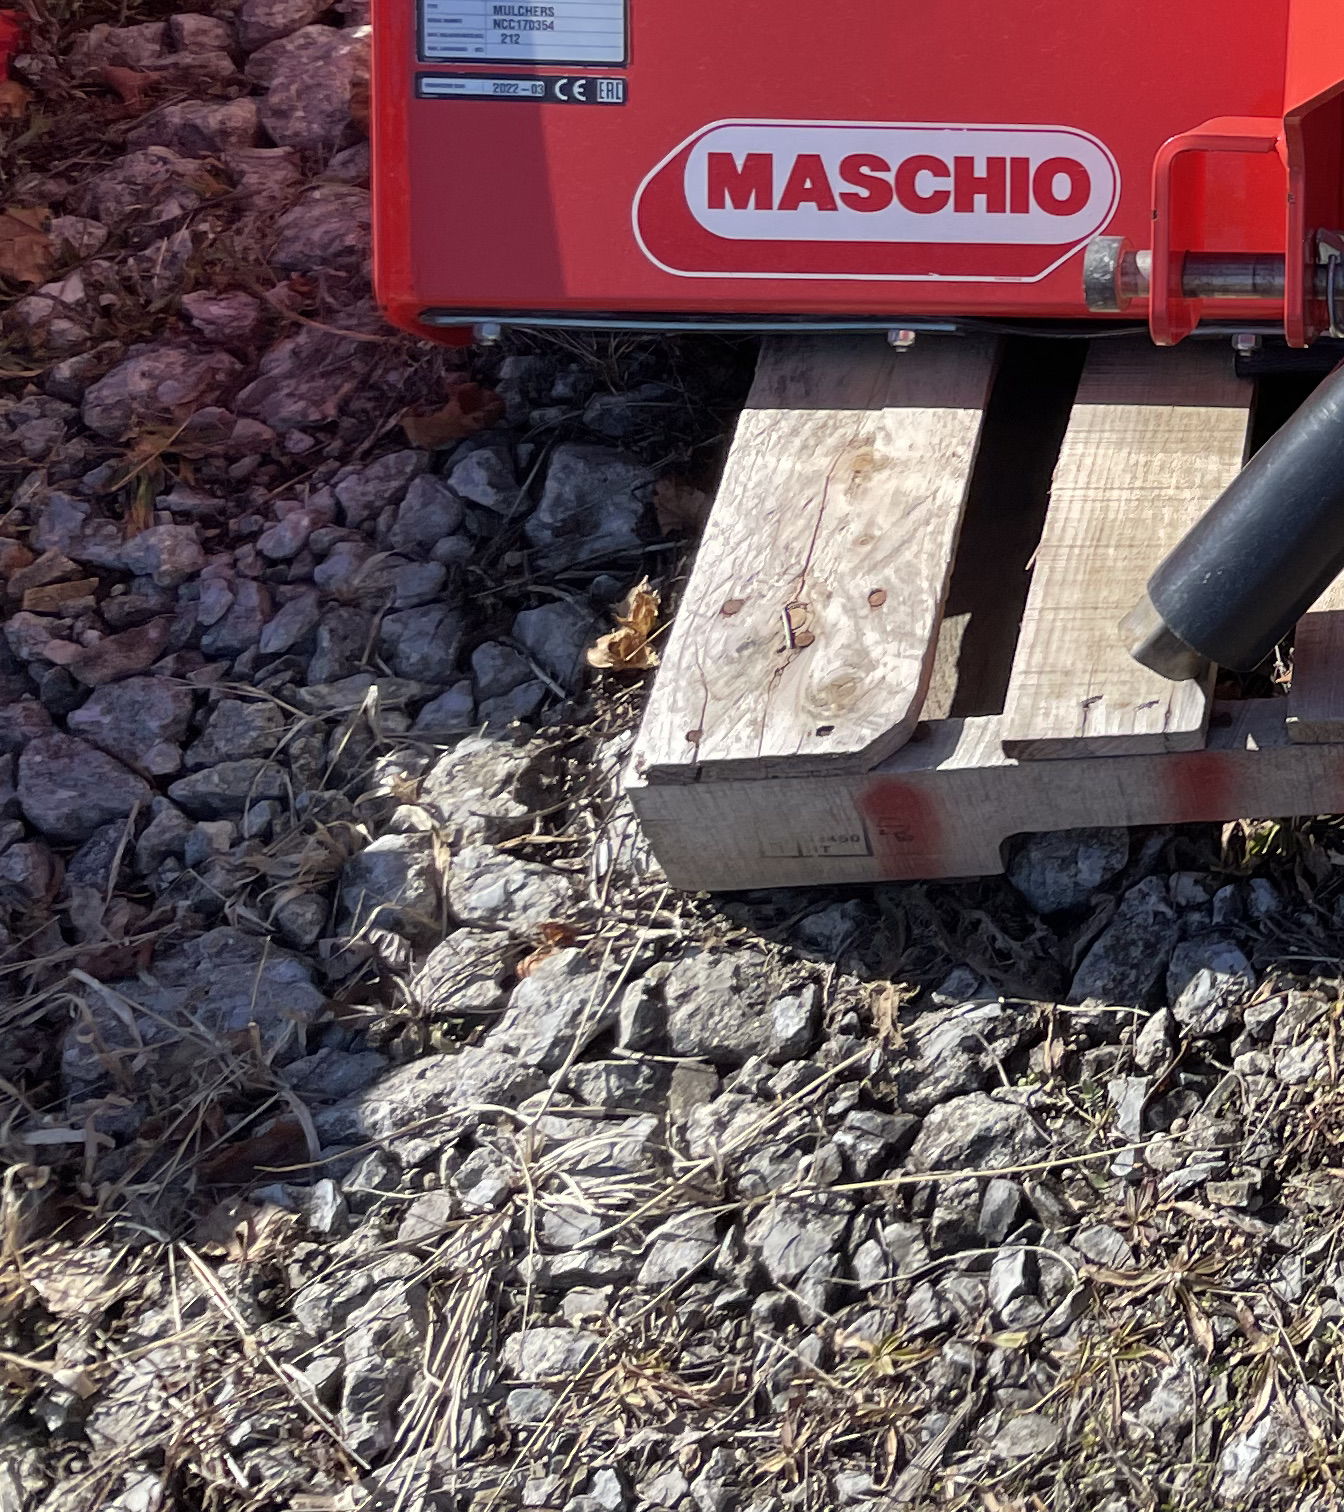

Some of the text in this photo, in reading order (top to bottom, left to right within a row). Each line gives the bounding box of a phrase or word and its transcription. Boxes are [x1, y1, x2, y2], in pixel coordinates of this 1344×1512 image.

[493, 5, 555, 17] MULCHERS
[500, 33, 521, 44] 212
[707, 151, 1092, 216] MASCHIO
